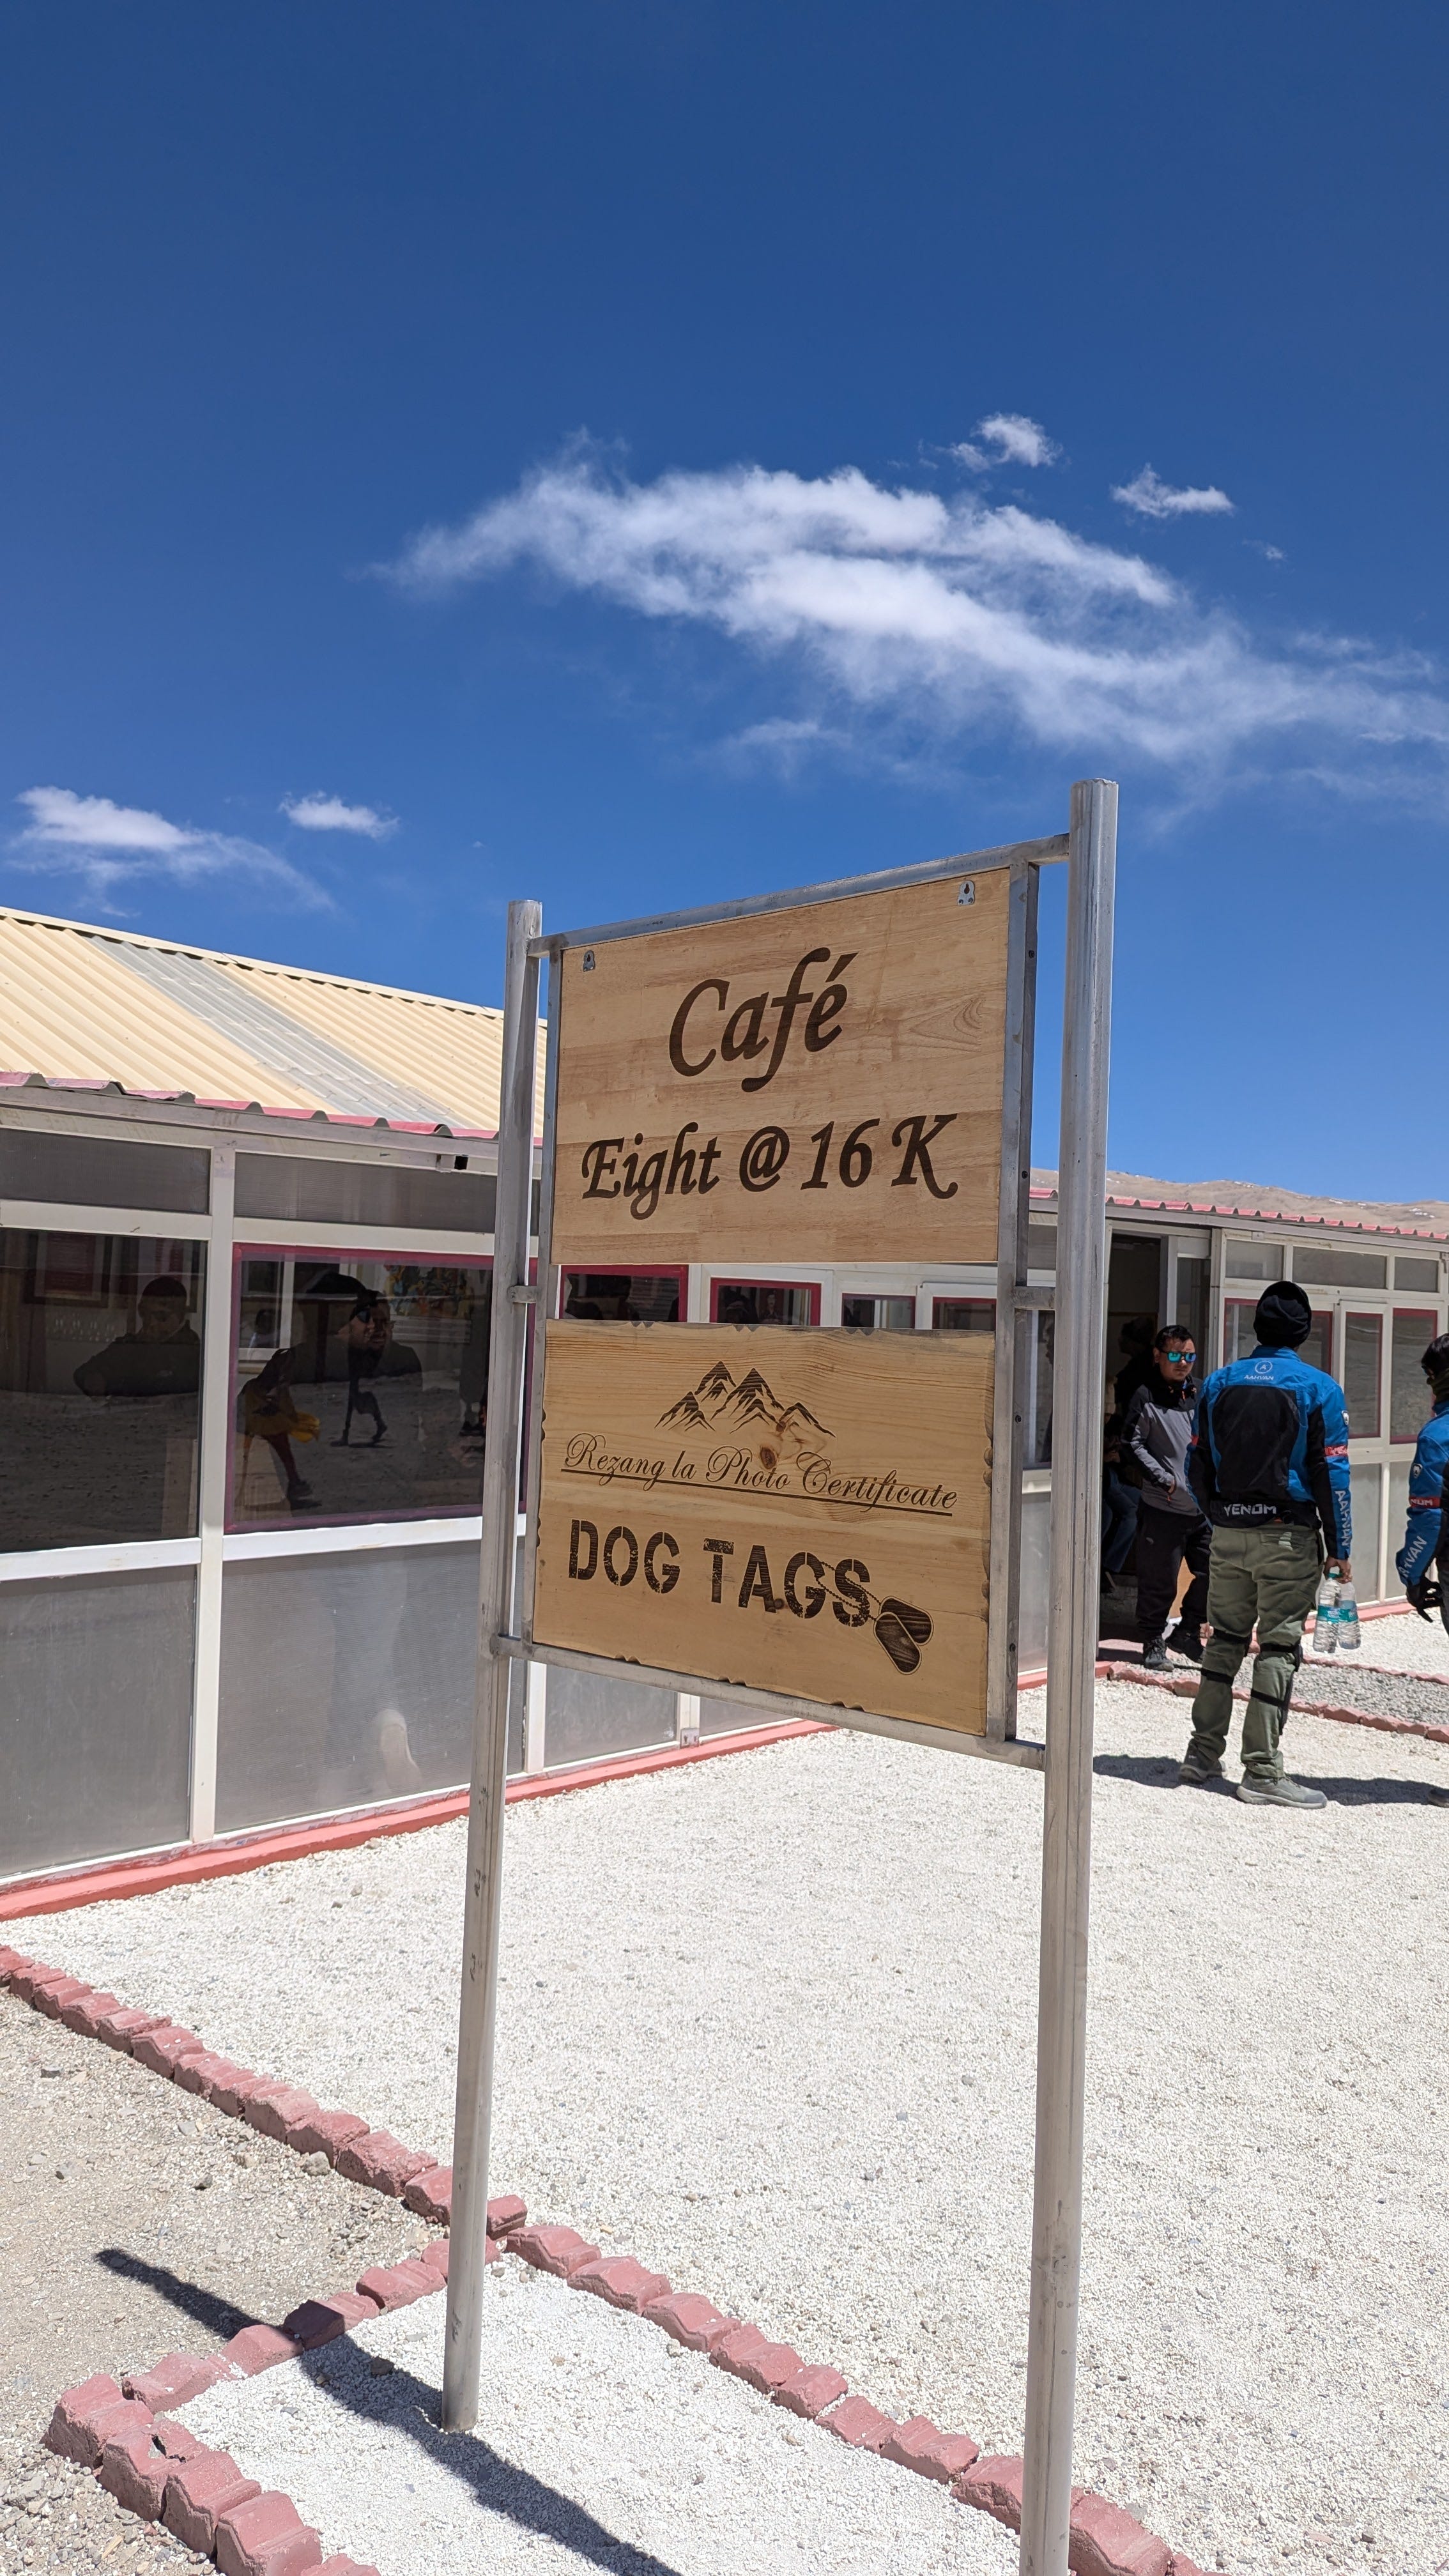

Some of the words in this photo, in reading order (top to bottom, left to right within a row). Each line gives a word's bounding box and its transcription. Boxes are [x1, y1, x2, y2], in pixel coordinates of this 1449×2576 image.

[669, 947, 859, 1092] Café
[581, 1122, 722, 1220] Eight
[739, 1126, 790, 1192] @
[801, 1117, 880, 1190] 16
[891, 1113, 958, 1200] K
[565, 1432, 666, 1491] Rezang
[671, 1450, 697, 1480] la
[705, 1445, 792, 1491] Photo
[795, 1451, 958, 1514] Certificate
[1223, 1503, 1277, 1517] VENOM
[568, 1519, 680, 1594] DOG
[703, 1538, 870, 1628] TAGS
